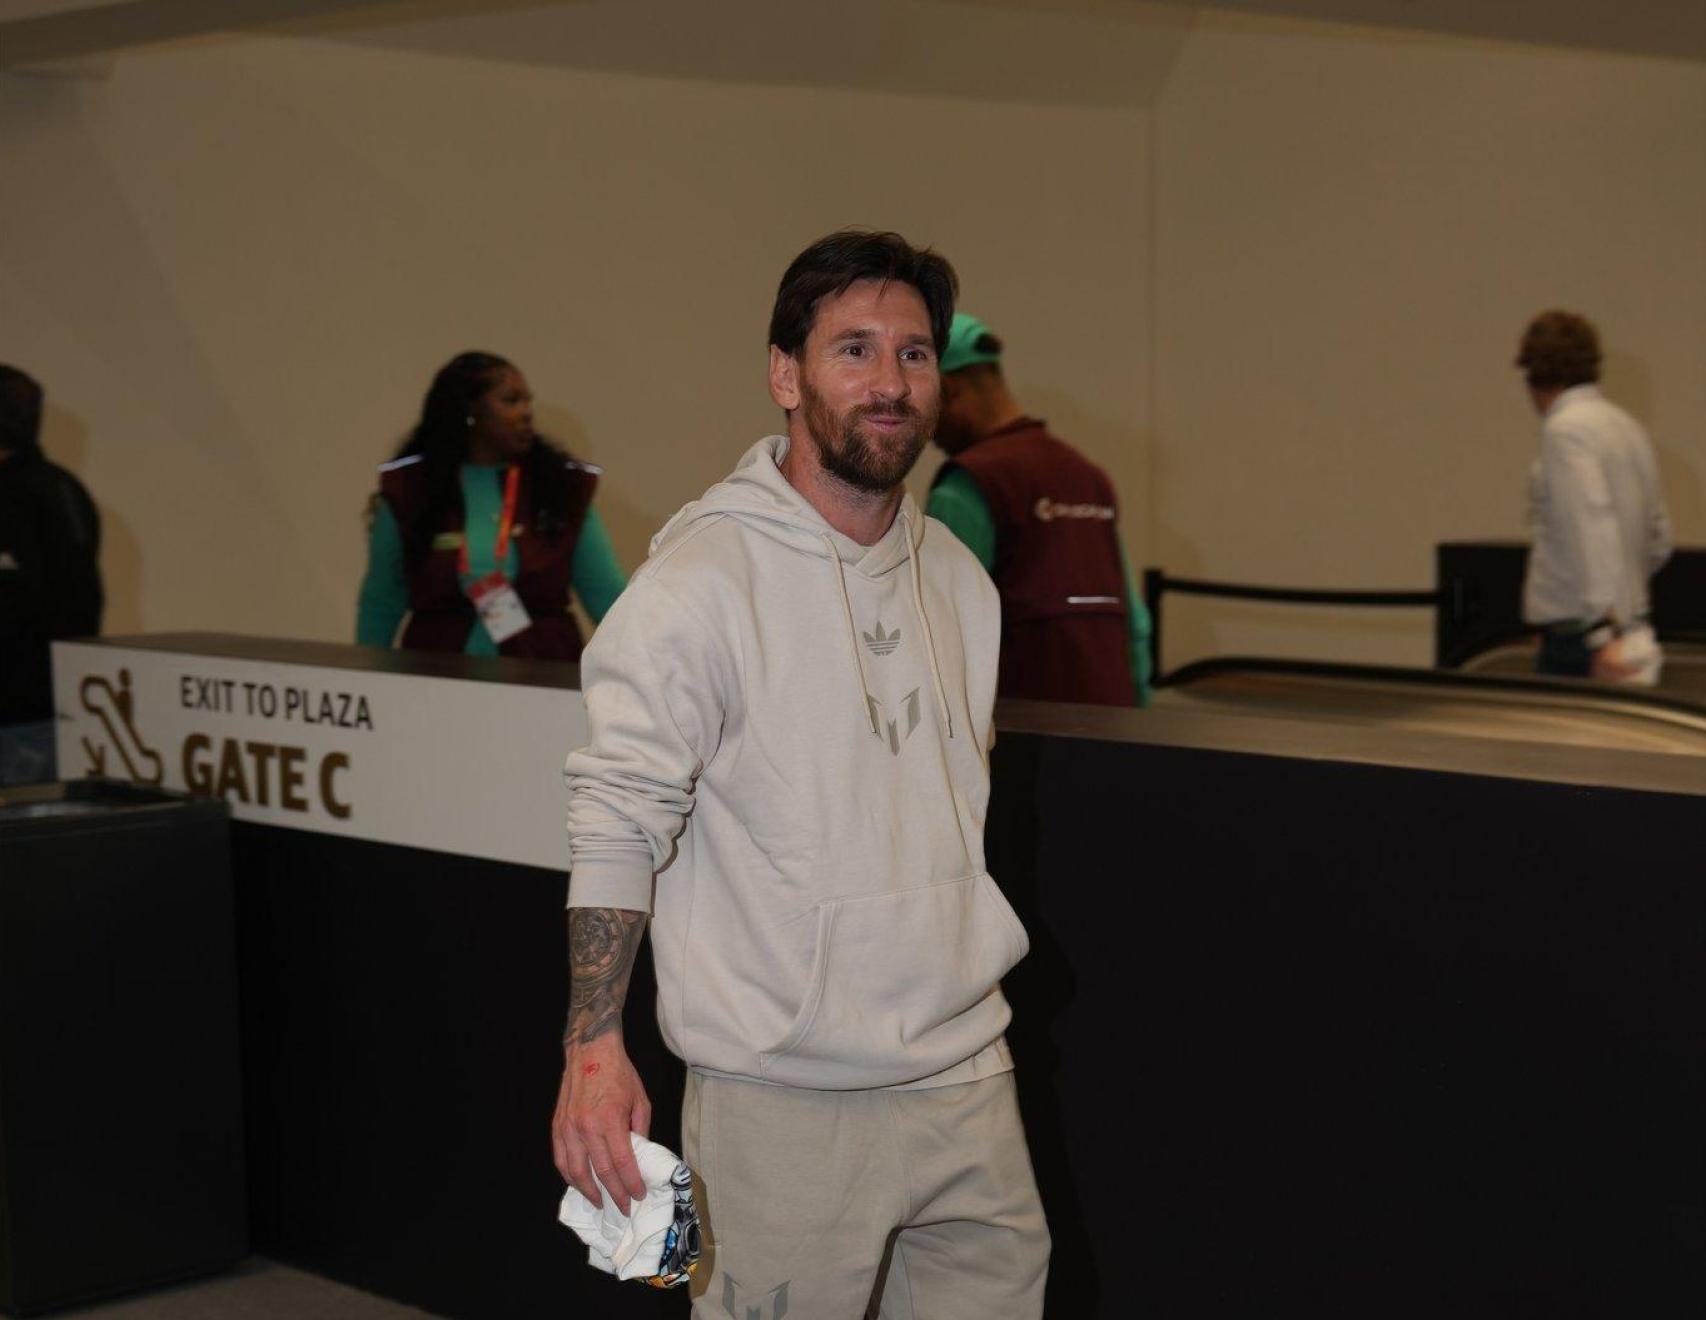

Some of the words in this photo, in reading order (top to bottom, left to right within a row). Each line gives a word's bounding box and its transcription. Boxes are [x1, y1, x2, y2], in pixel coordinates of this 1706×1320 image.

[180, 675, 235, 713] EXIT
[243, 683, 277, 719] TO
[285, 687, 374, 731] PLAZA
[182, 733, 309, 813] GATE
[319, 751, 353, 820] C
